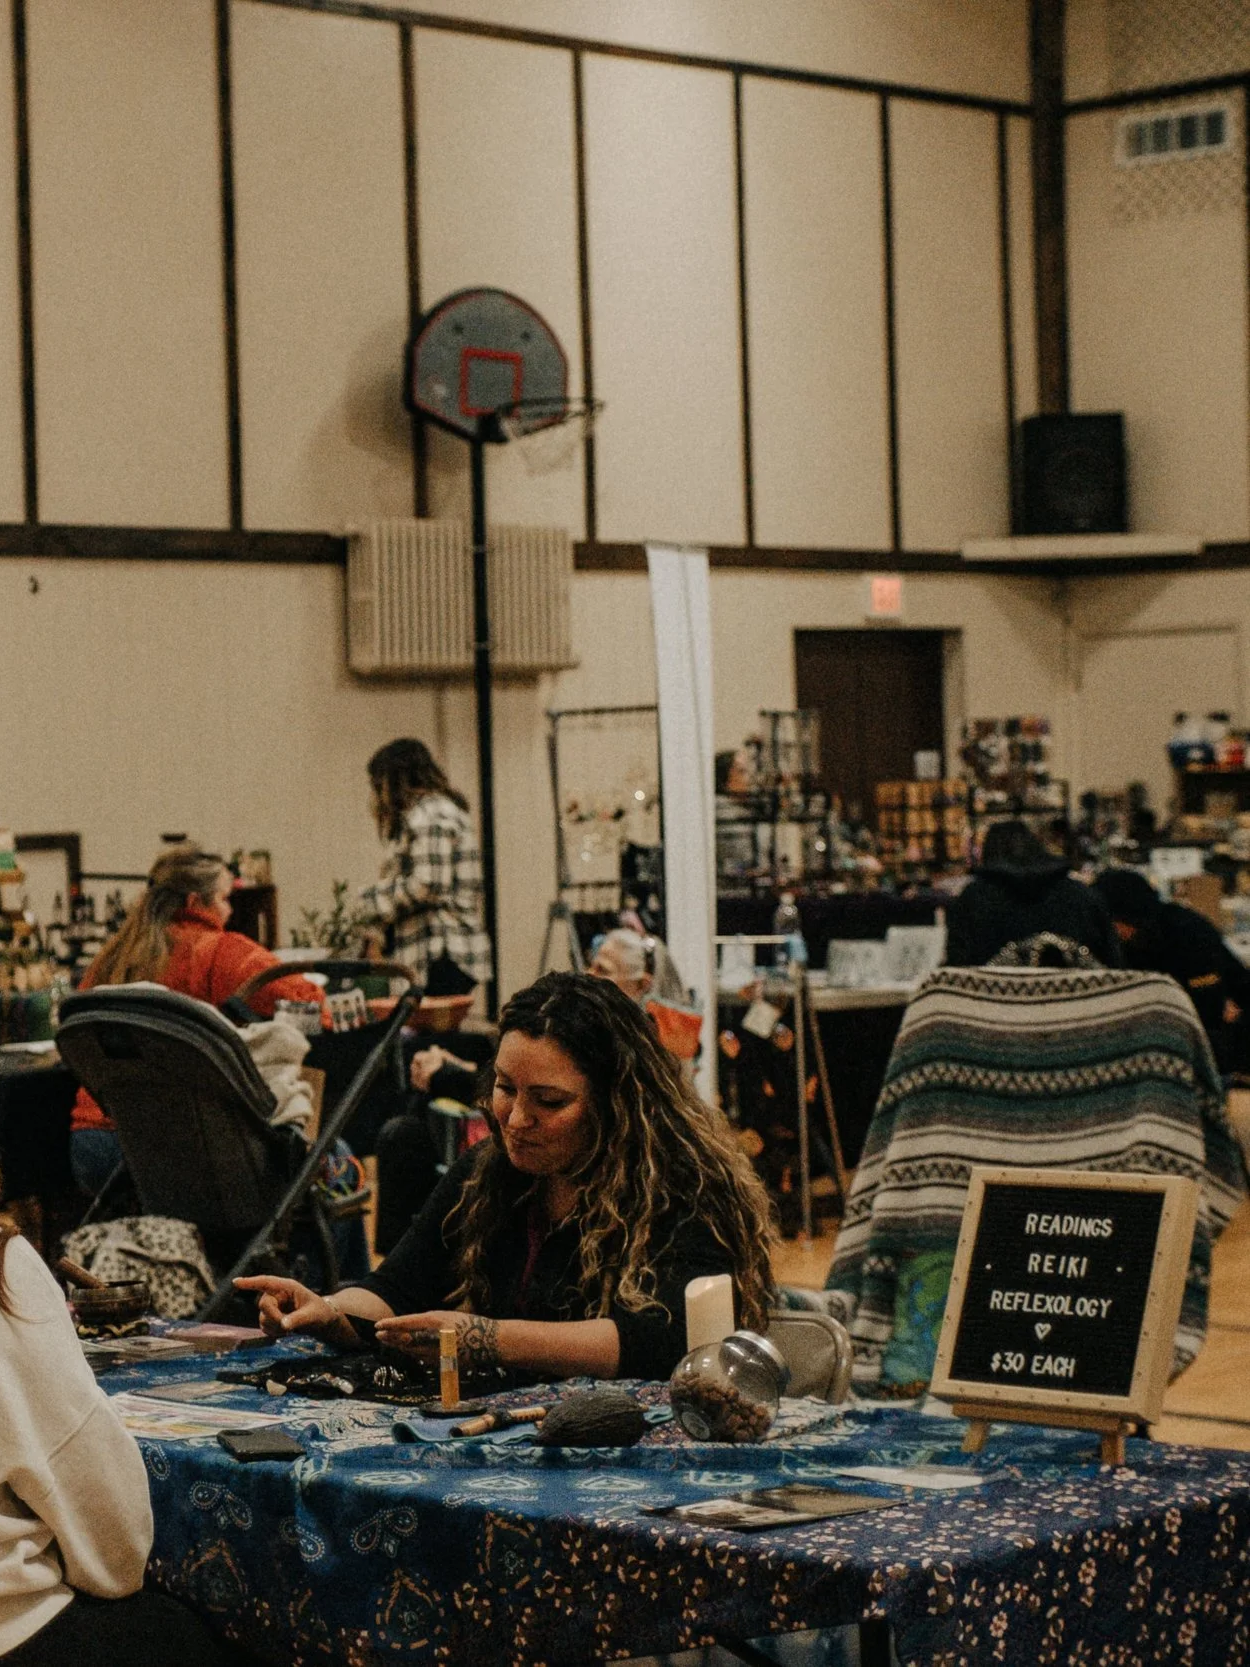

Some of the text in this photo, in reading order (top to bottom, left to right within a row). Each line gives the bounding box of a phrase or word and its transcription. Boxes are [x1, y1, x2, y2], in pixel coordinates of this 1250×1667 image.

[1025, 1213, 1113, 1238] READINGS
[1028, 1253, 1088, 1279] REIKI
[990, 1290, 1112, 1318] REFLEXOLOGY
[991, 1352, 1076, 1378] $30 EACH
